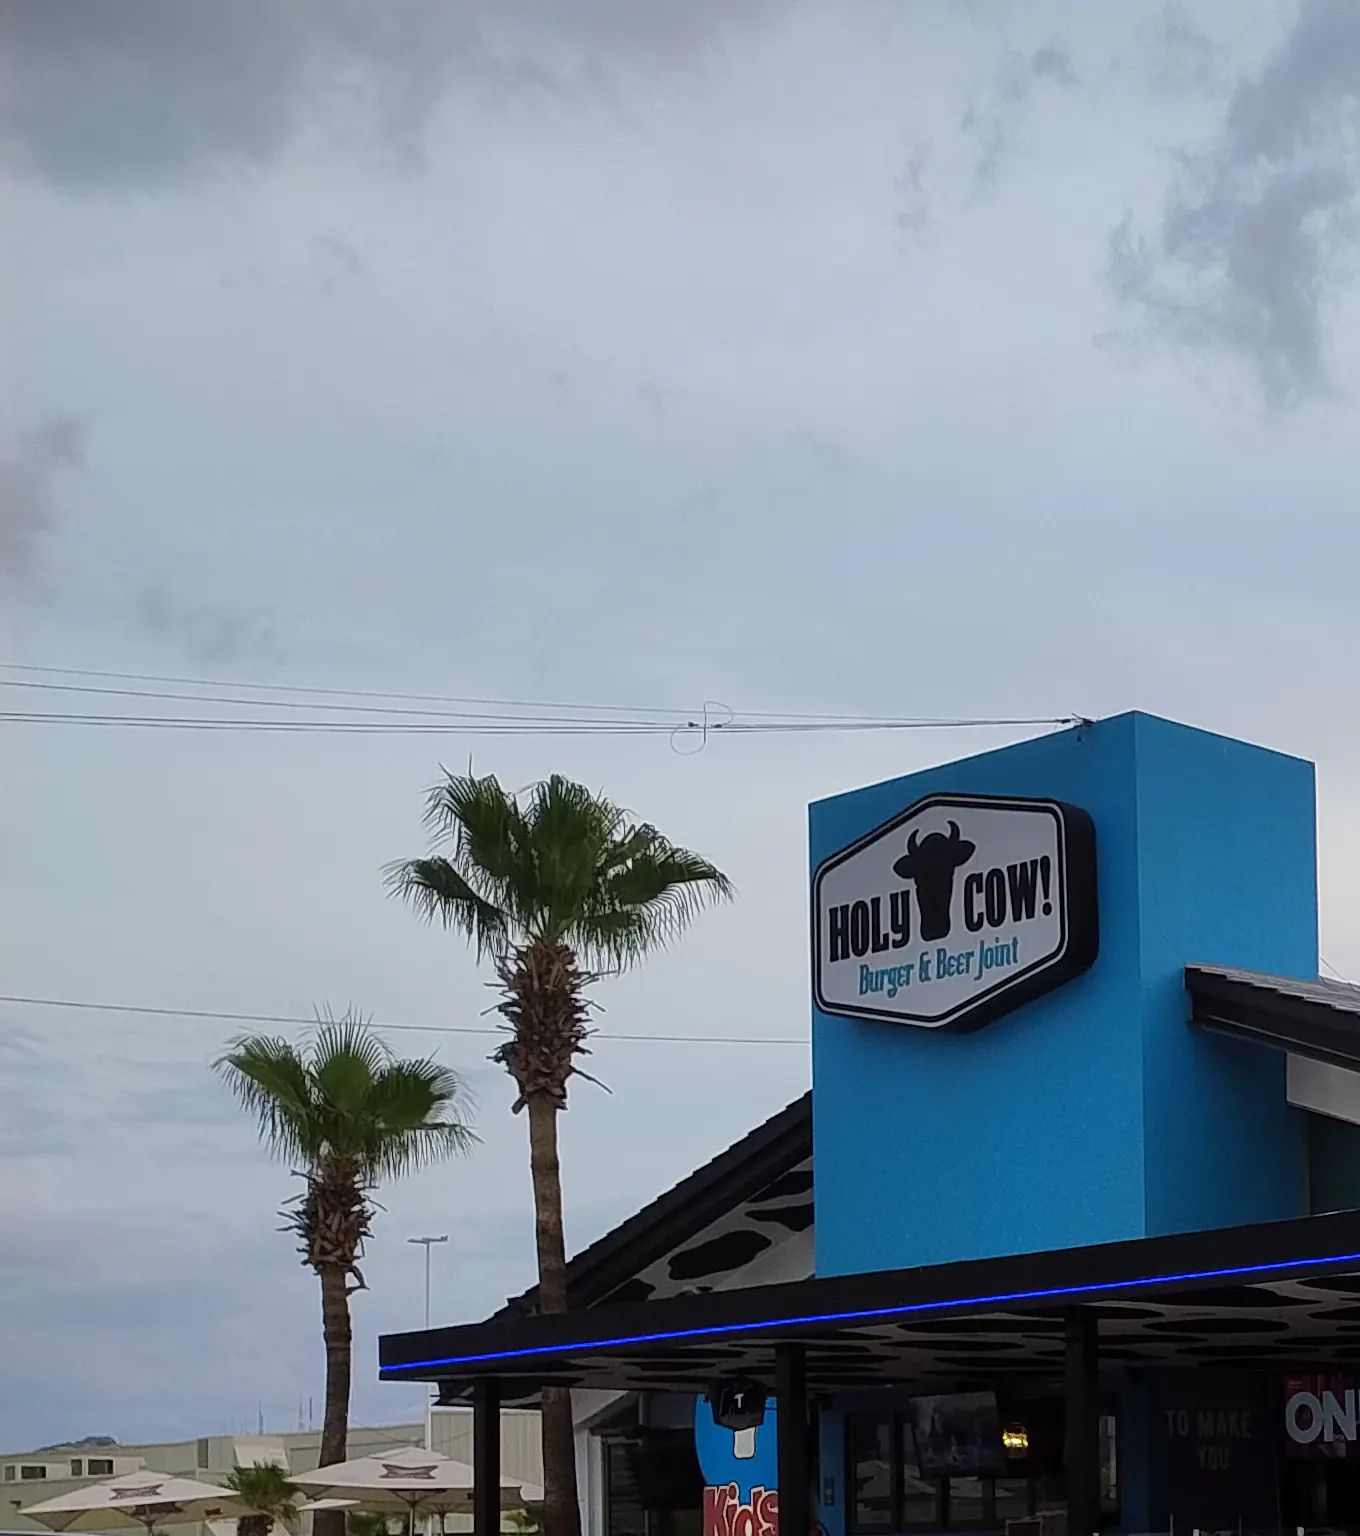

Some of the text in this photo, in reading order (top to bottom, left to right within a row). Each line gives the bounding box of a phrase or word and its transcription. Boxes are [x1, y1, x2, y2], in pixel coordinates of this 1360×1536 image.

[829, 855, 1053, 963] HOLY COW!
[859, 937, 1019, 999] Burger & Beer Joint
[1165, 1409, 1254, 1438] TO MAKE
[1197, 1446, 1230, 1470] YOU
